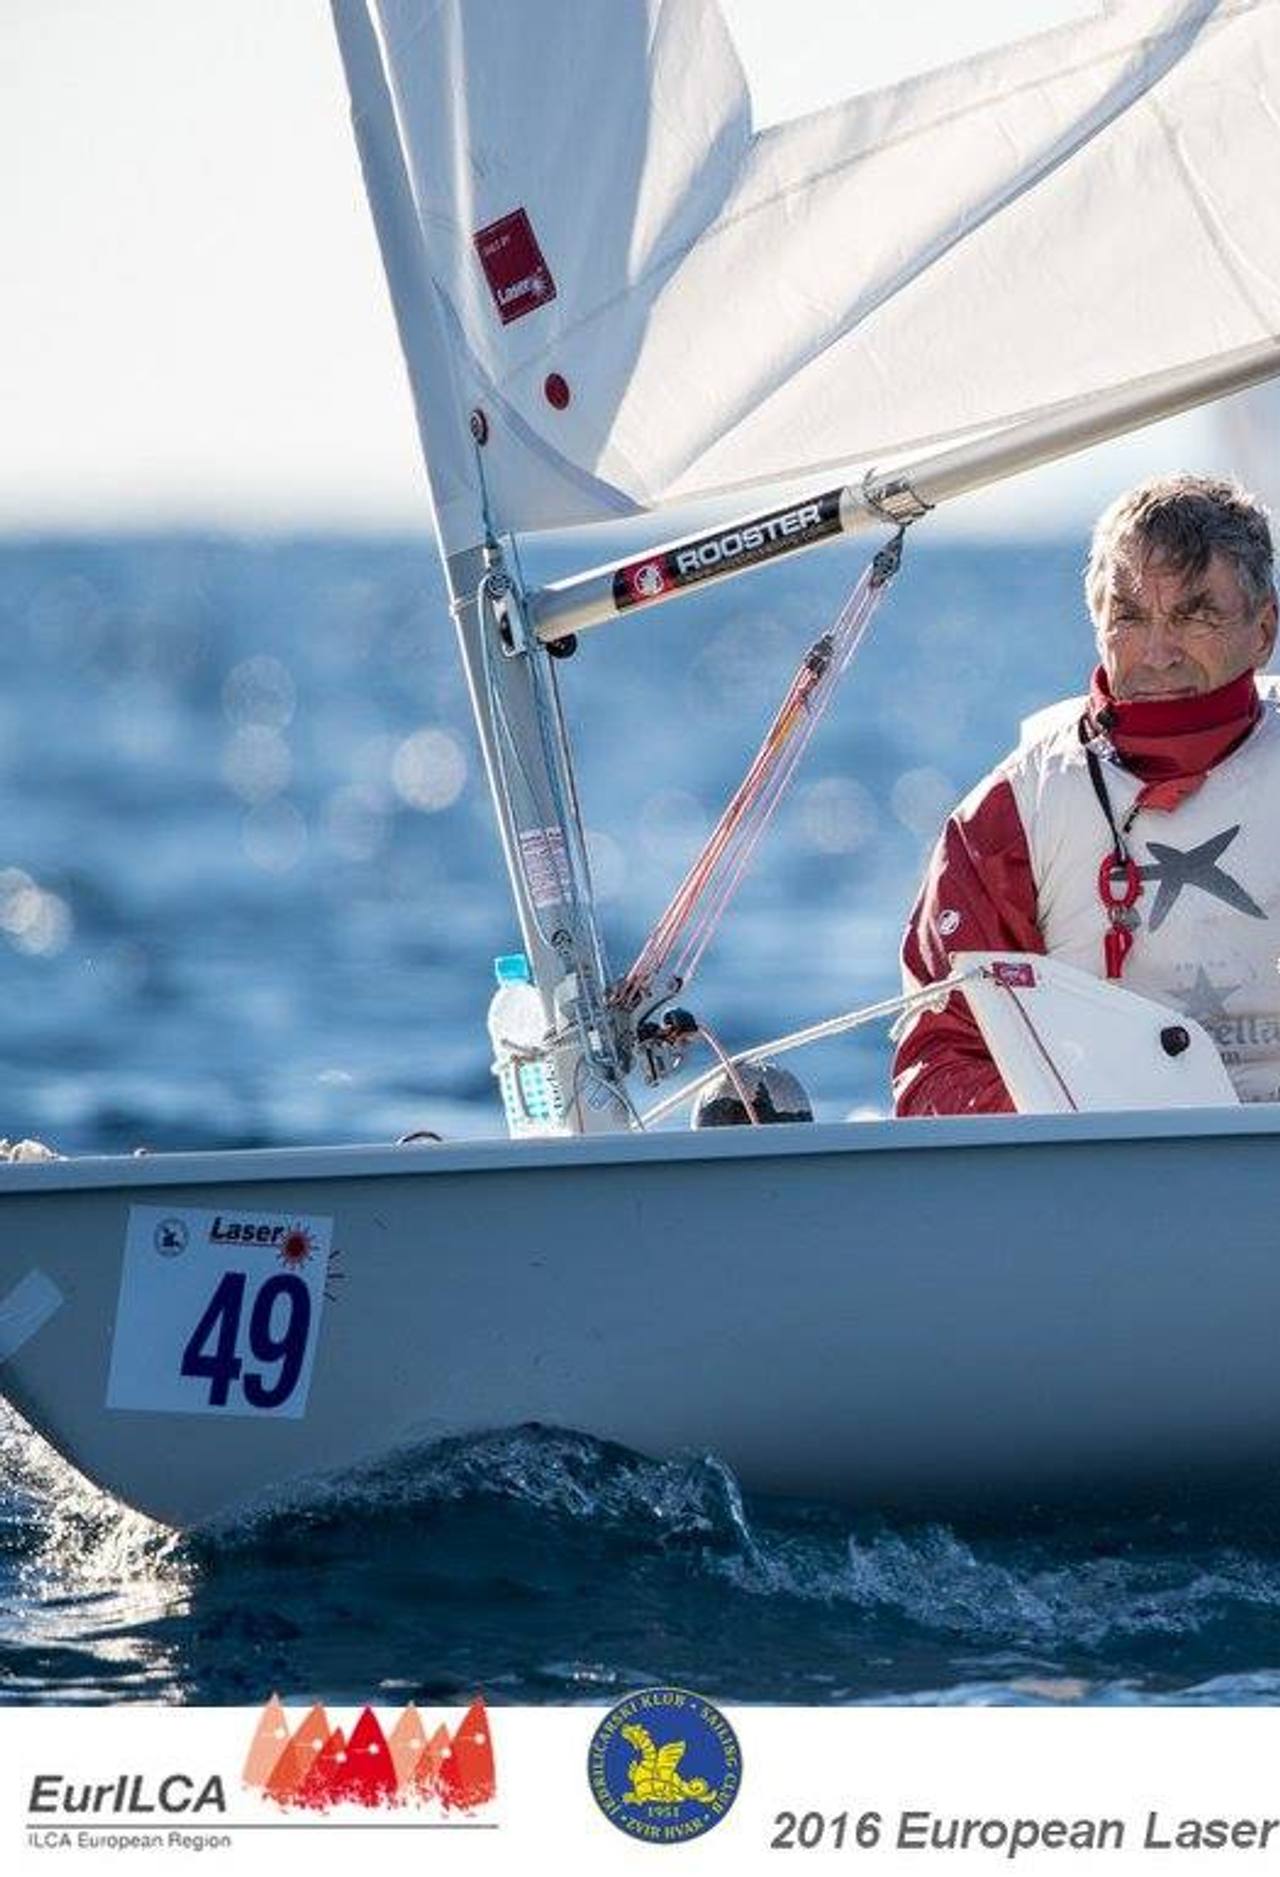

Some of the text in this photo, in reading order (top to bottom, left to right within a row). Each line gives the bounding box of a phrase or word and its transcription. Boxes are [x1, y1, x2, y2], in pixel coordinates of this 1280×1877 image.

[676, 504, 822, 574] ROOSTER
[210, 1216, 285, 1242] Laser
[179, 1271, 311, 1409] 49
